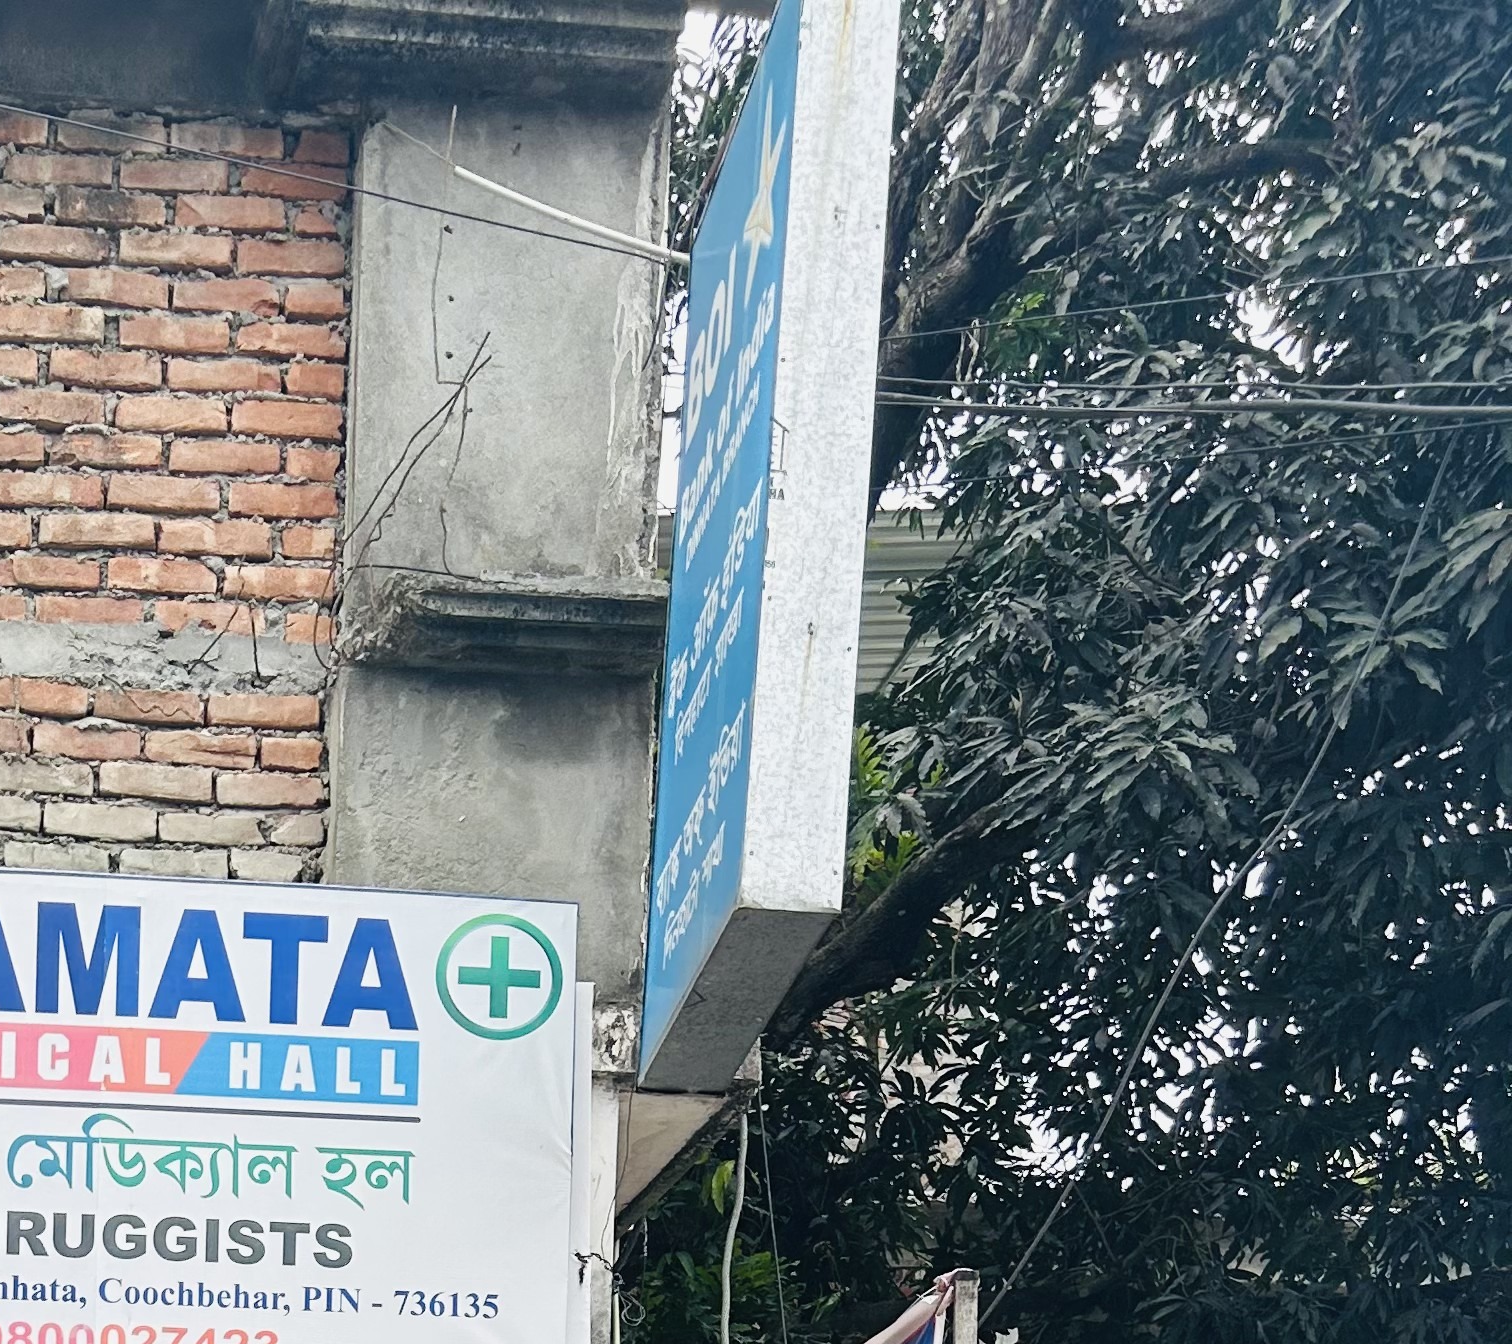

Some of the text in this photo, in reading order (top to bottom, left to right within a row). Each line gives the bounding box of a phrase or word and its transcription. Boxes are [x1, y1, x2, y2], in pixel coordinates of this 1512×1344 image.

[679, 282, 775, 548] Bank of India
[686, 241, 737, 450] BOI
[686, 371, 760, 573] DINHATA BRANCH
[229, 1042, 406, 1096] HALL
[7, 1113, 298, 1199] মেডিক্যাল
[316, 1146, 416, 1210] হল
[99, 1277, 290, 1316] Coochbehar,
[301, 1286, 361, 1314] PIN
[394, 1289, 499, 1320] 736135
